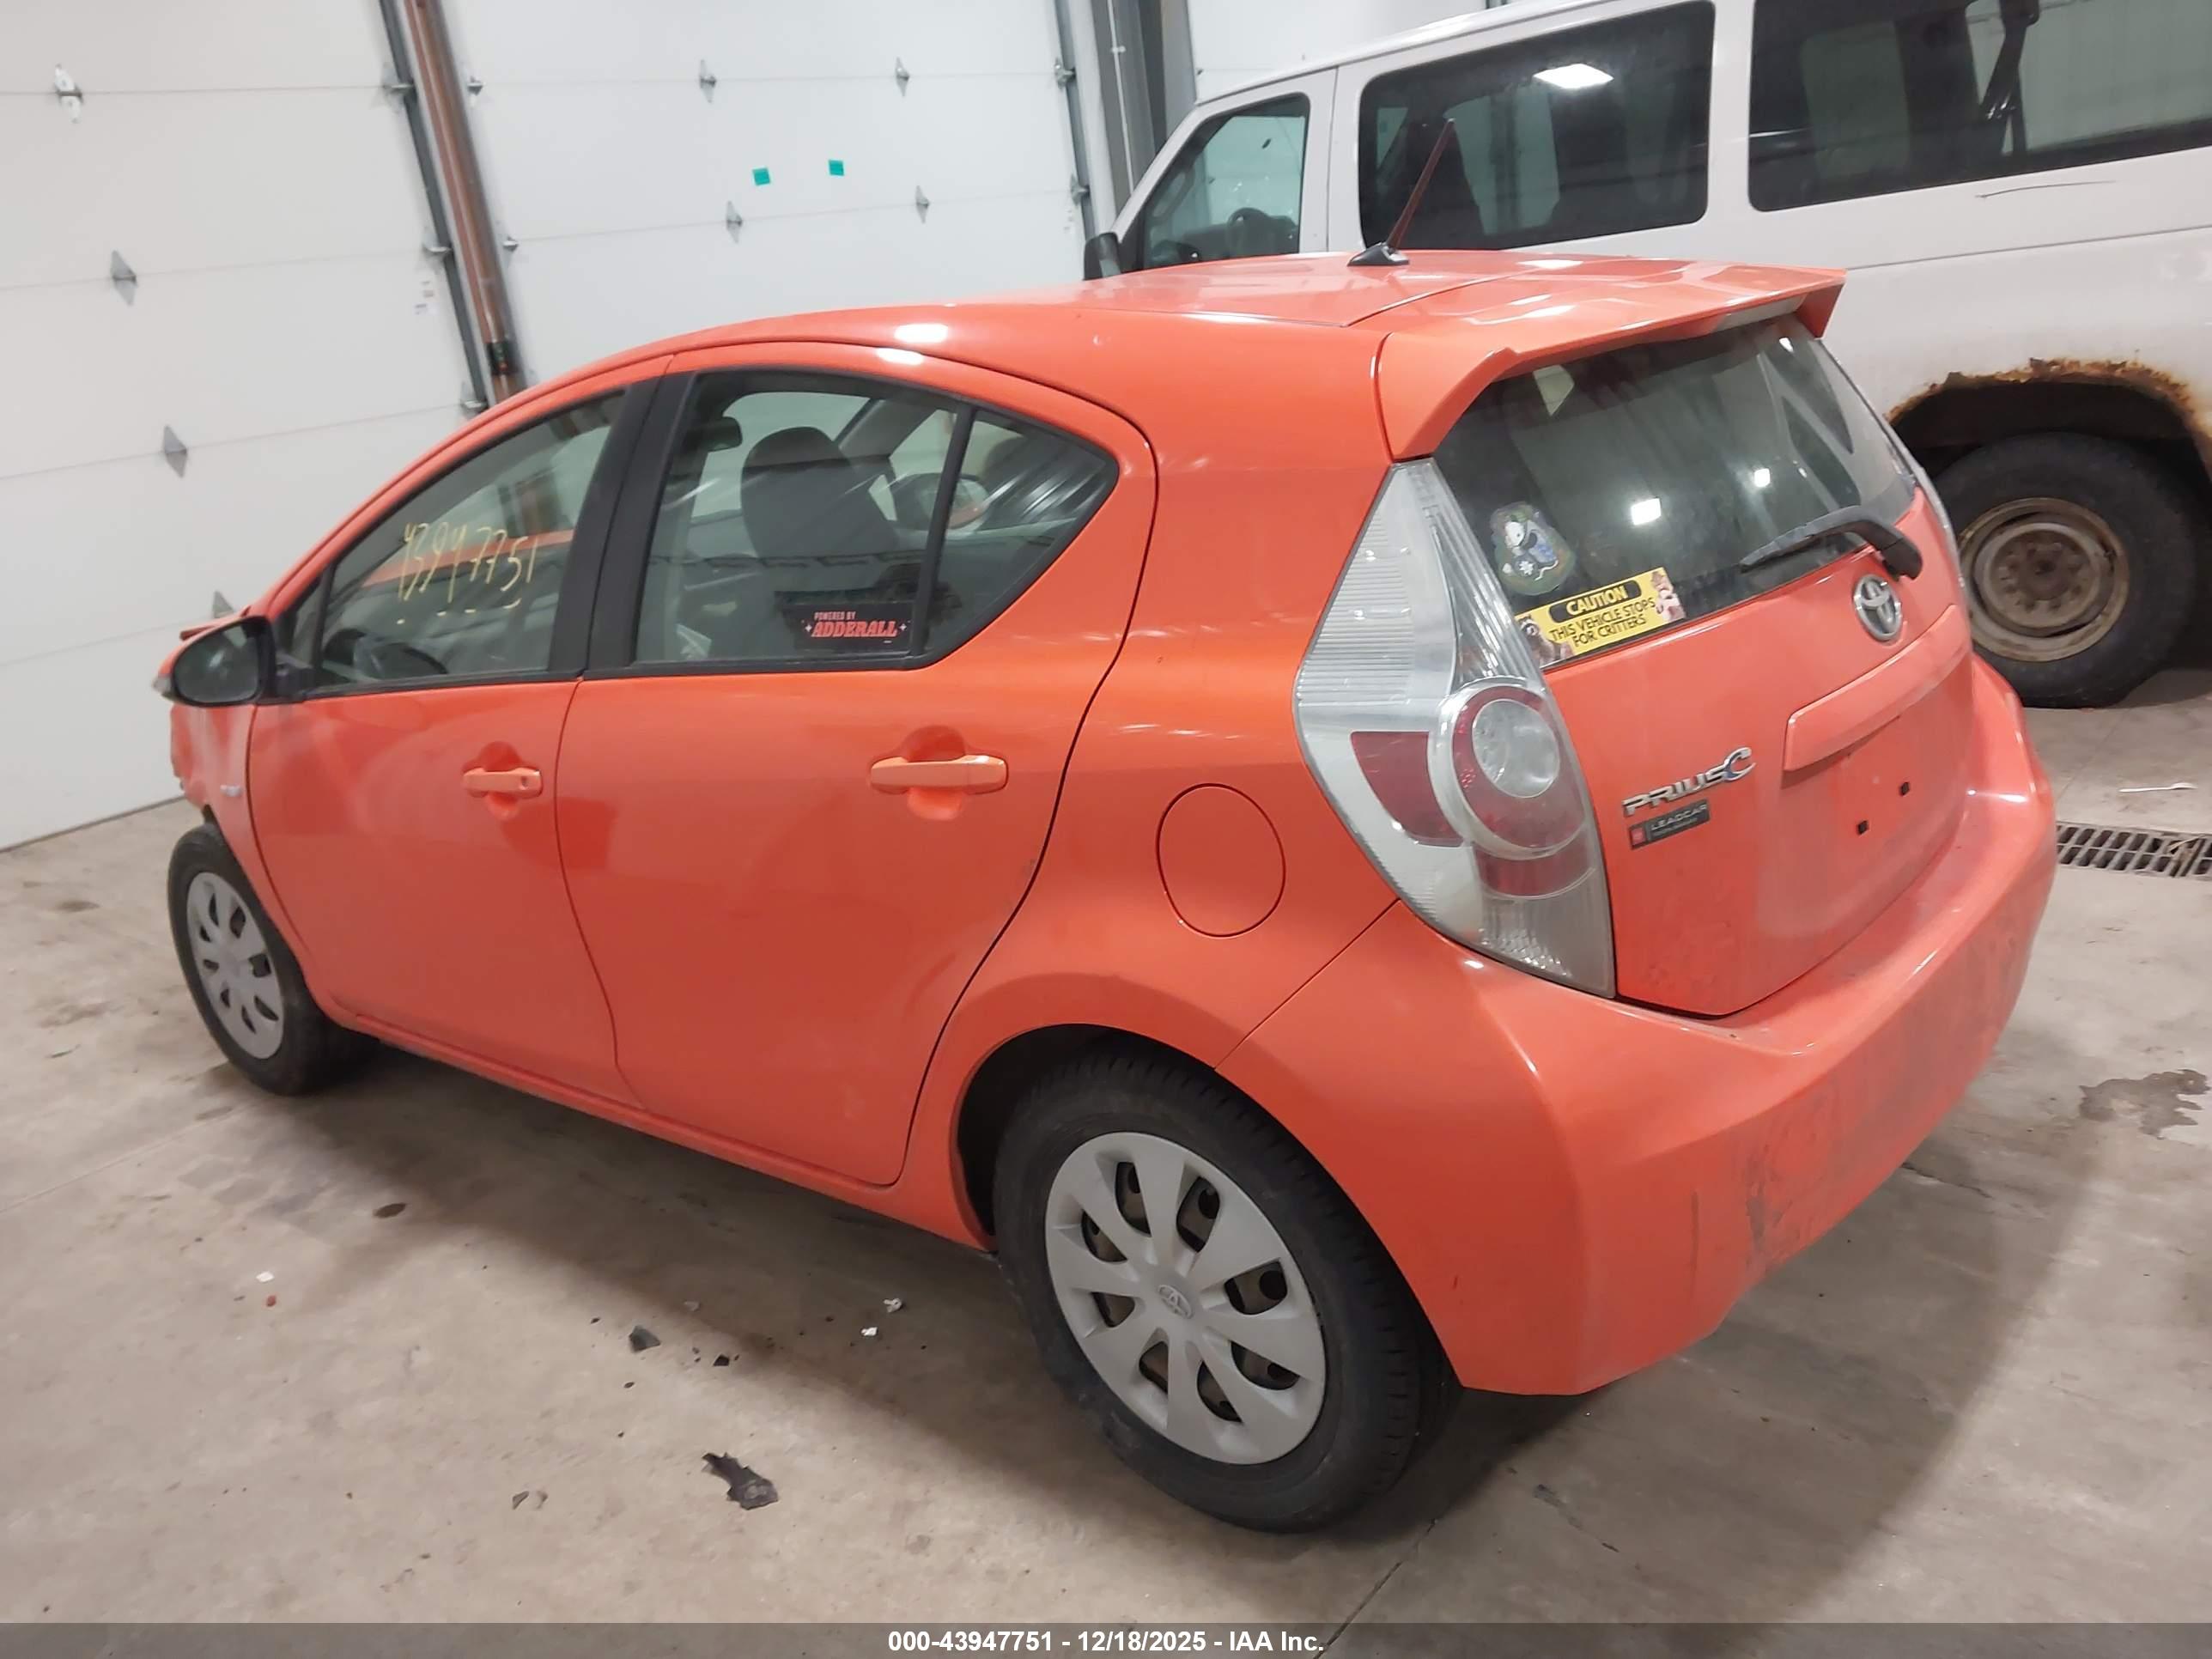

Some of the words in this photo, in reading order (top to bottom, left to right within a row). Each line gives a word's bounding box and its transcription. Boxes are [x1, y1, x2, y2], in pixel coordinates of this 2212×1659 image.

[814, 611, 845, 620] POWERED
[847, 611, 856, 620] BY
[1566, 586, 1628, 616] CAUTION
[811, 621, 897, 637] ADDERALL
[1549, 625, 1577, 641] THIS
[1577, 609, 1623, 632] VEHICLE
[1624, 597, 1656, 617] STOPS
[1572, 630, 1595, 647] FOR
[1598, 614, 1646, 638] CRITTERS
